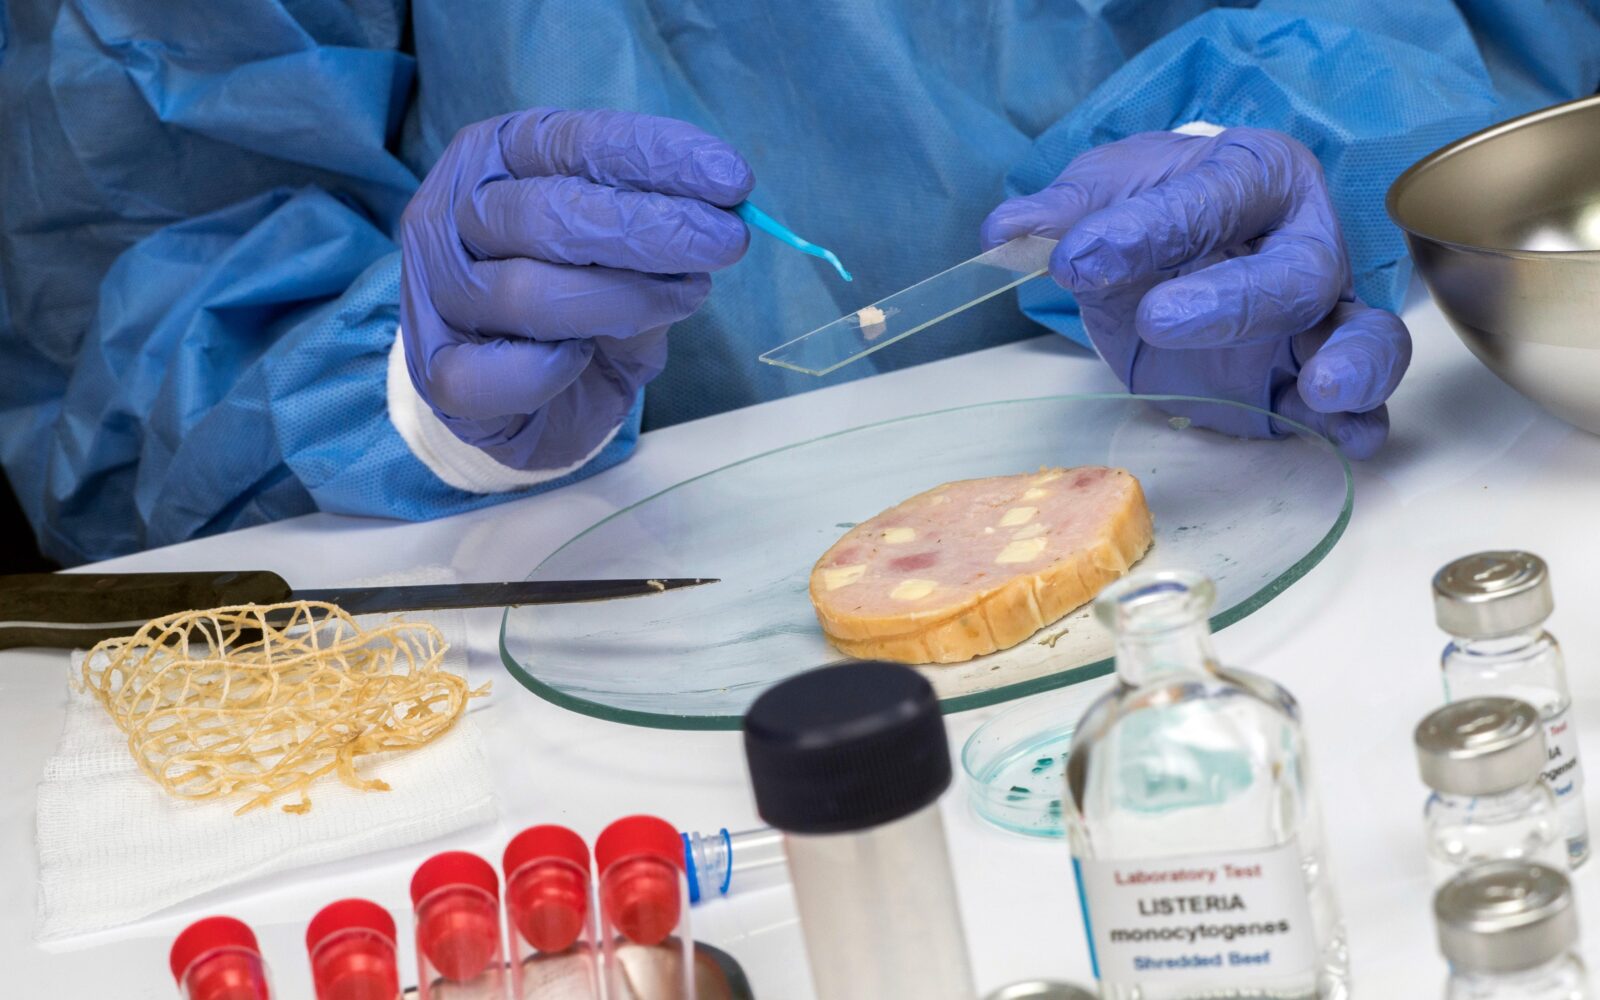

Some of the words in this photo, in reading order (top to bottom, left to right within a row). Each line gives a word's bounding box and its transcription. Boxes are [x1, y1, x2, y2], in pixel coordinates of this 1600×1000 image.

[1114, 868, 1216, 885] Laboratory
[1224, 864, 1262, 879] Test
[1138, 894, 1246, 916] LISTERIA
[1110, 920, 1290, 943] monocytogenes
[1134, 953, 1221, 971] Shredded
[1229, 951, 1270, 967] Beef
